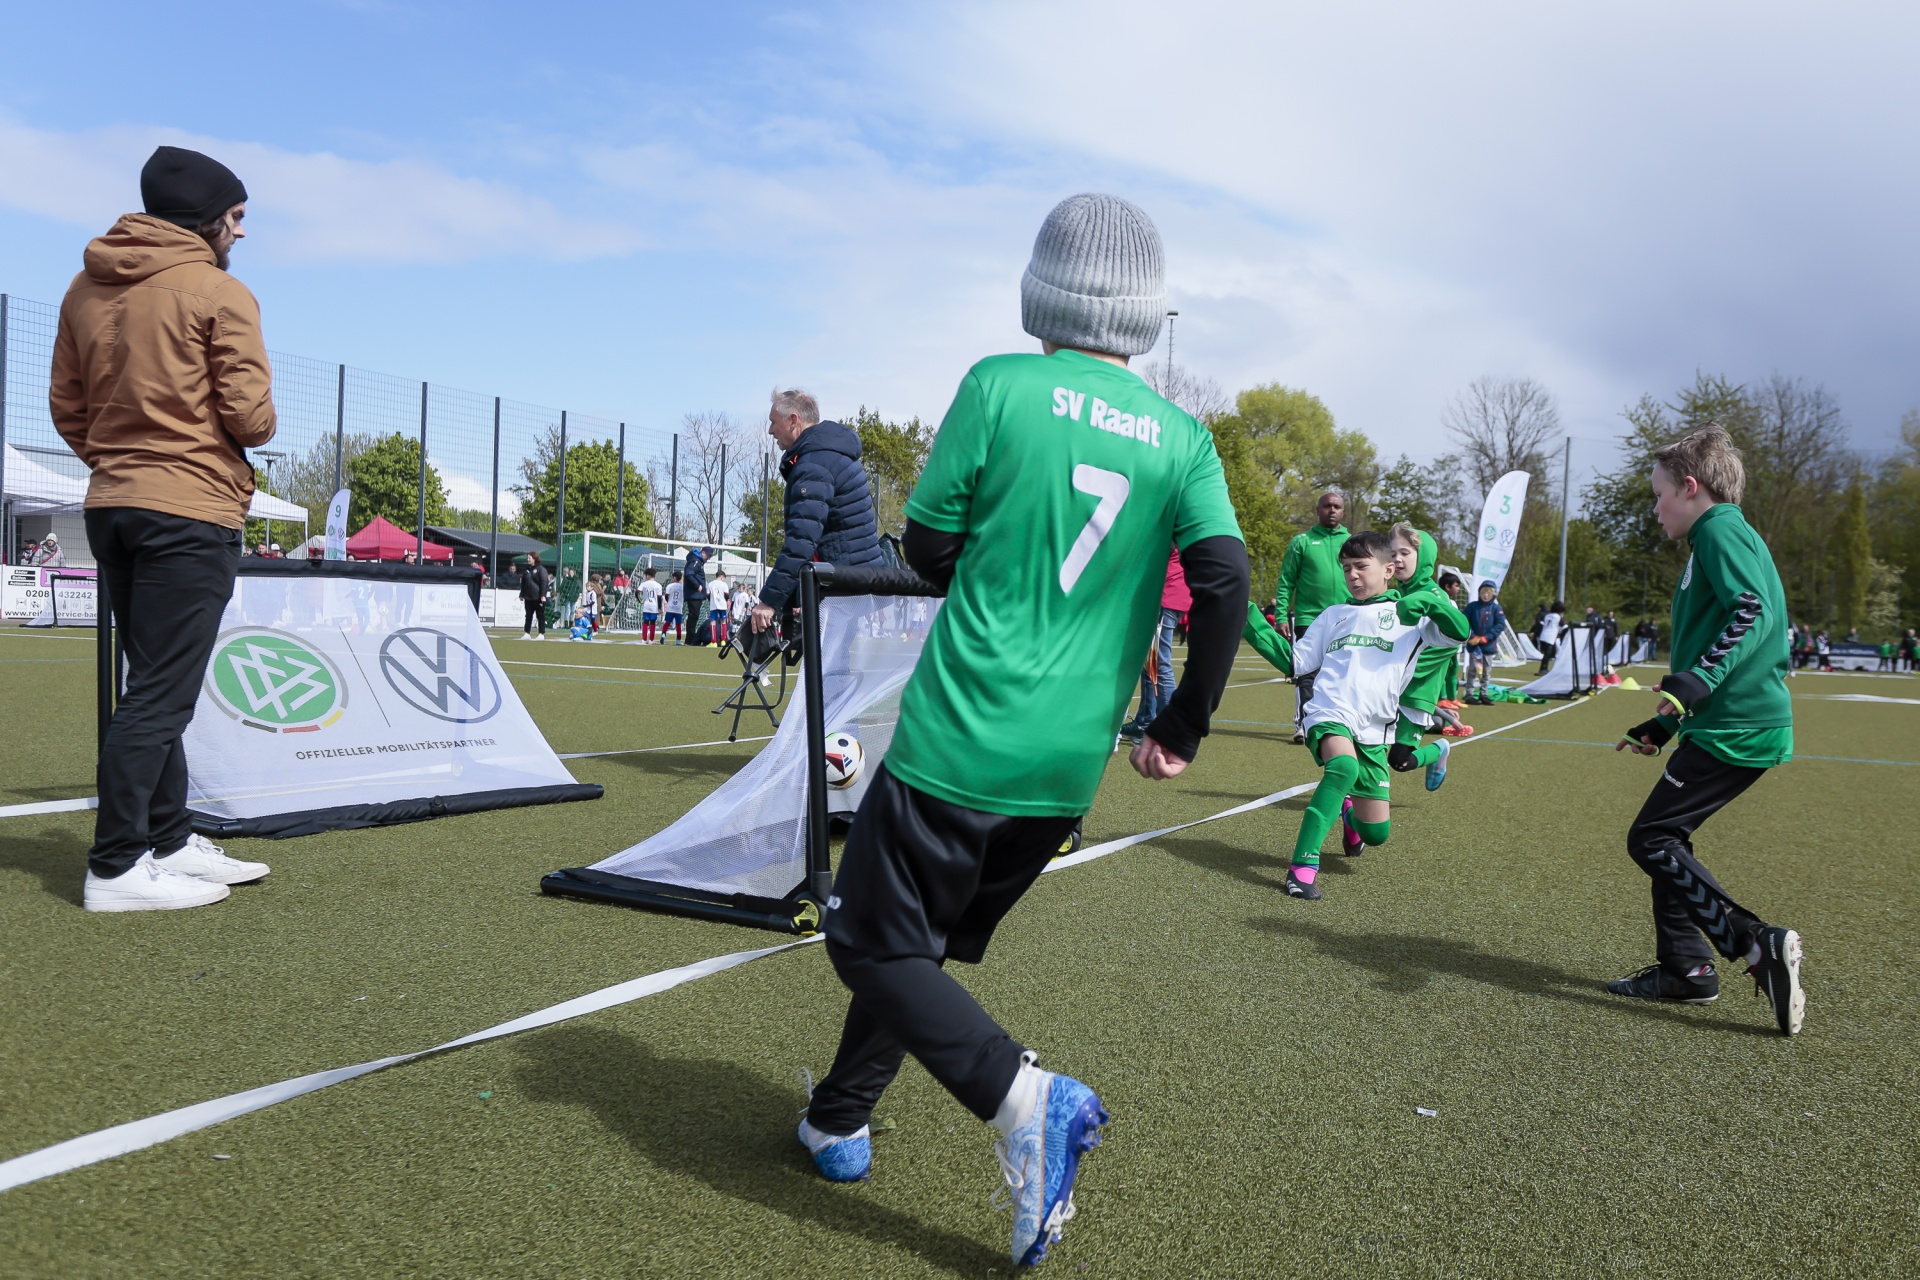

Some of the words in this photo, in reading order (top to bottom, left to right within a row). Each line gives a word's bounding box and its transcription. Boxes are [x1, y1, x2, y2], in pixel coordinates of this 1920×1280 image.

[1052, 386, 1086, 422] SV
[1089, 396, 1161, 448] Raadt
[334, 504, 342, 518] 9
[1500, 494, 1512, 515] 3
[1059, 463, 1130, 597] 7
[25, 589, 50, 598] 0208
[58, 591, 93, 599] 432242
[673, 590, 680, 600] 8
[1358, 637, 1365, 645] &
[296, 746, 374, 760] OFFIZIELLER
[376, 738, 498, 754] MOBILITÄTSPARTNER
